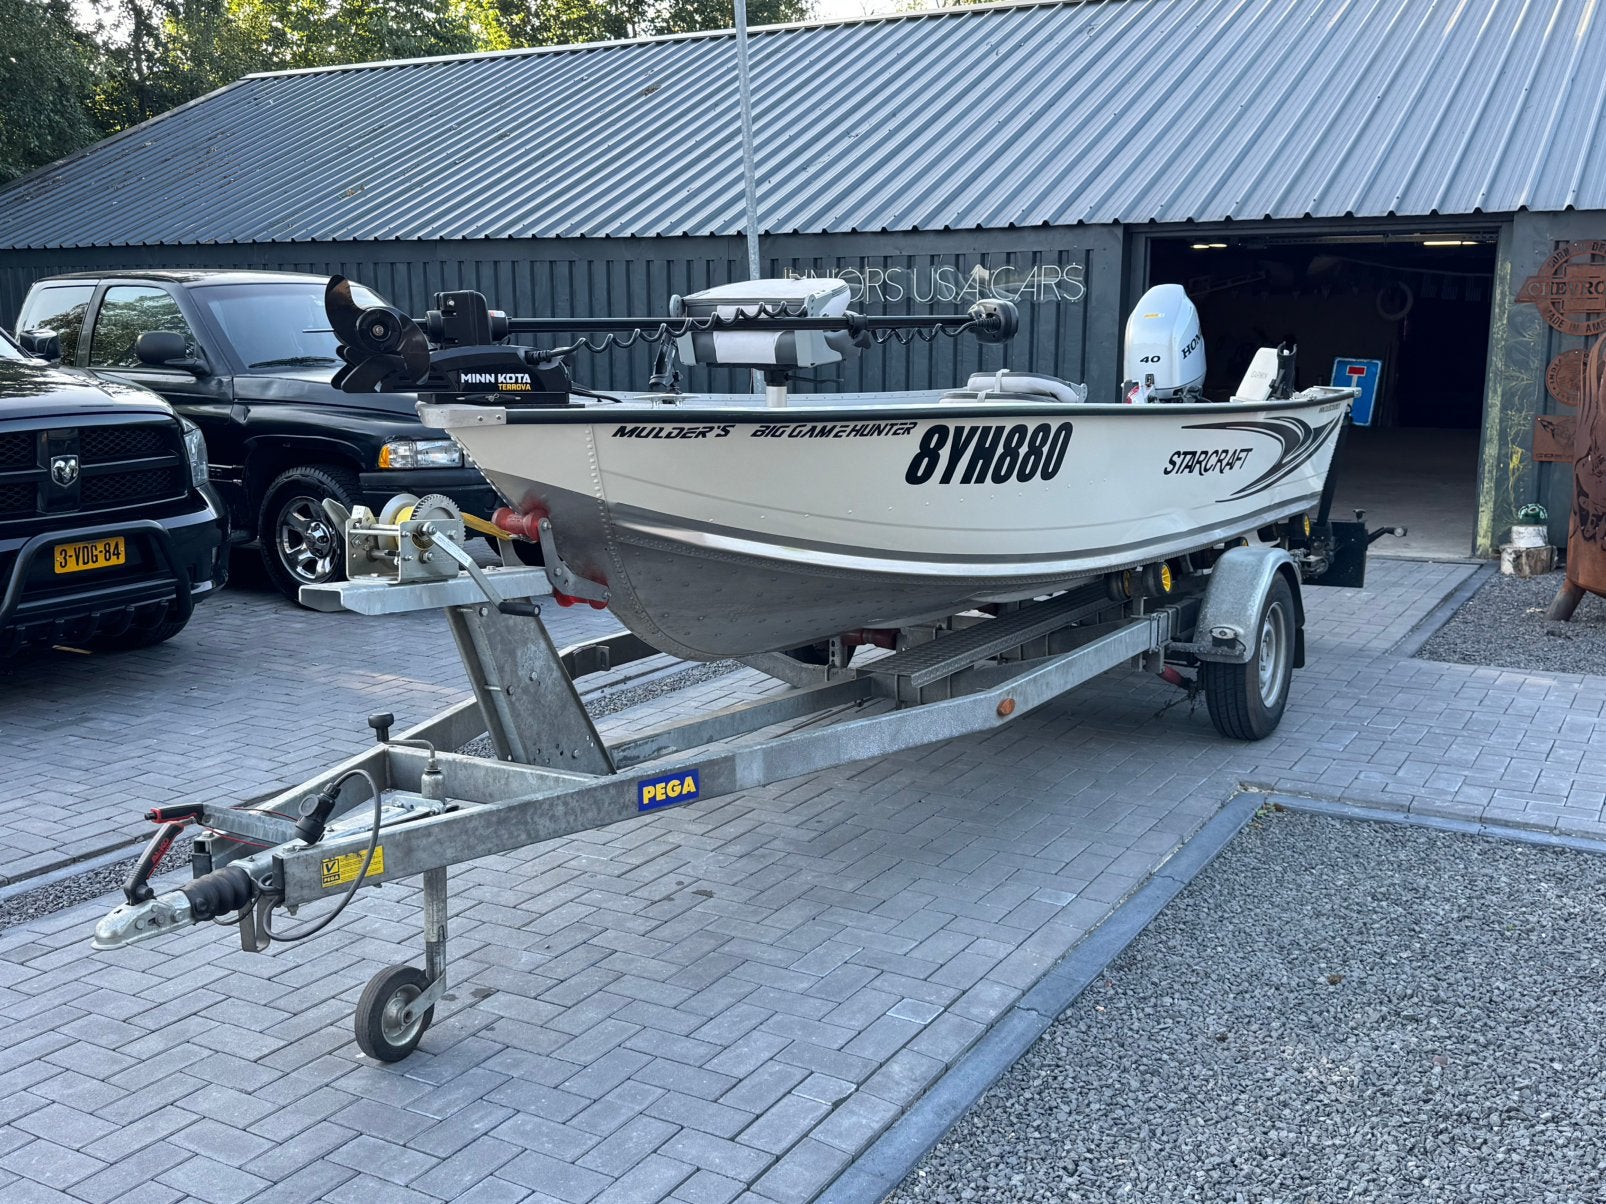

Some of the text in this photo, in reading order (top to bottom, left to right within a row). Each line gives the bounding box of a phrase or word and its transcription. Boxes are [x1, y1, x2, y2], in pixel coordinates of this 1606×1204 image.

[913, 267, 979, 302] USA
[991, 264, 1085, 302] CARS
[1139, 355, 1161, 364] 40
[460, 373, 532, 384] MINN KOTA
[498, 383, 532, 391] TERROVA
[611, 421, 918, 439] MULDER'S BIG GAME HUNTER
[904, 421, 1074, 486] 8YH880
[1163, 447, 1254, 477] STARCRAFT
[59, 540, 121, 569] 3-VDG-84
[642, 776, 697, 805] PEGA
